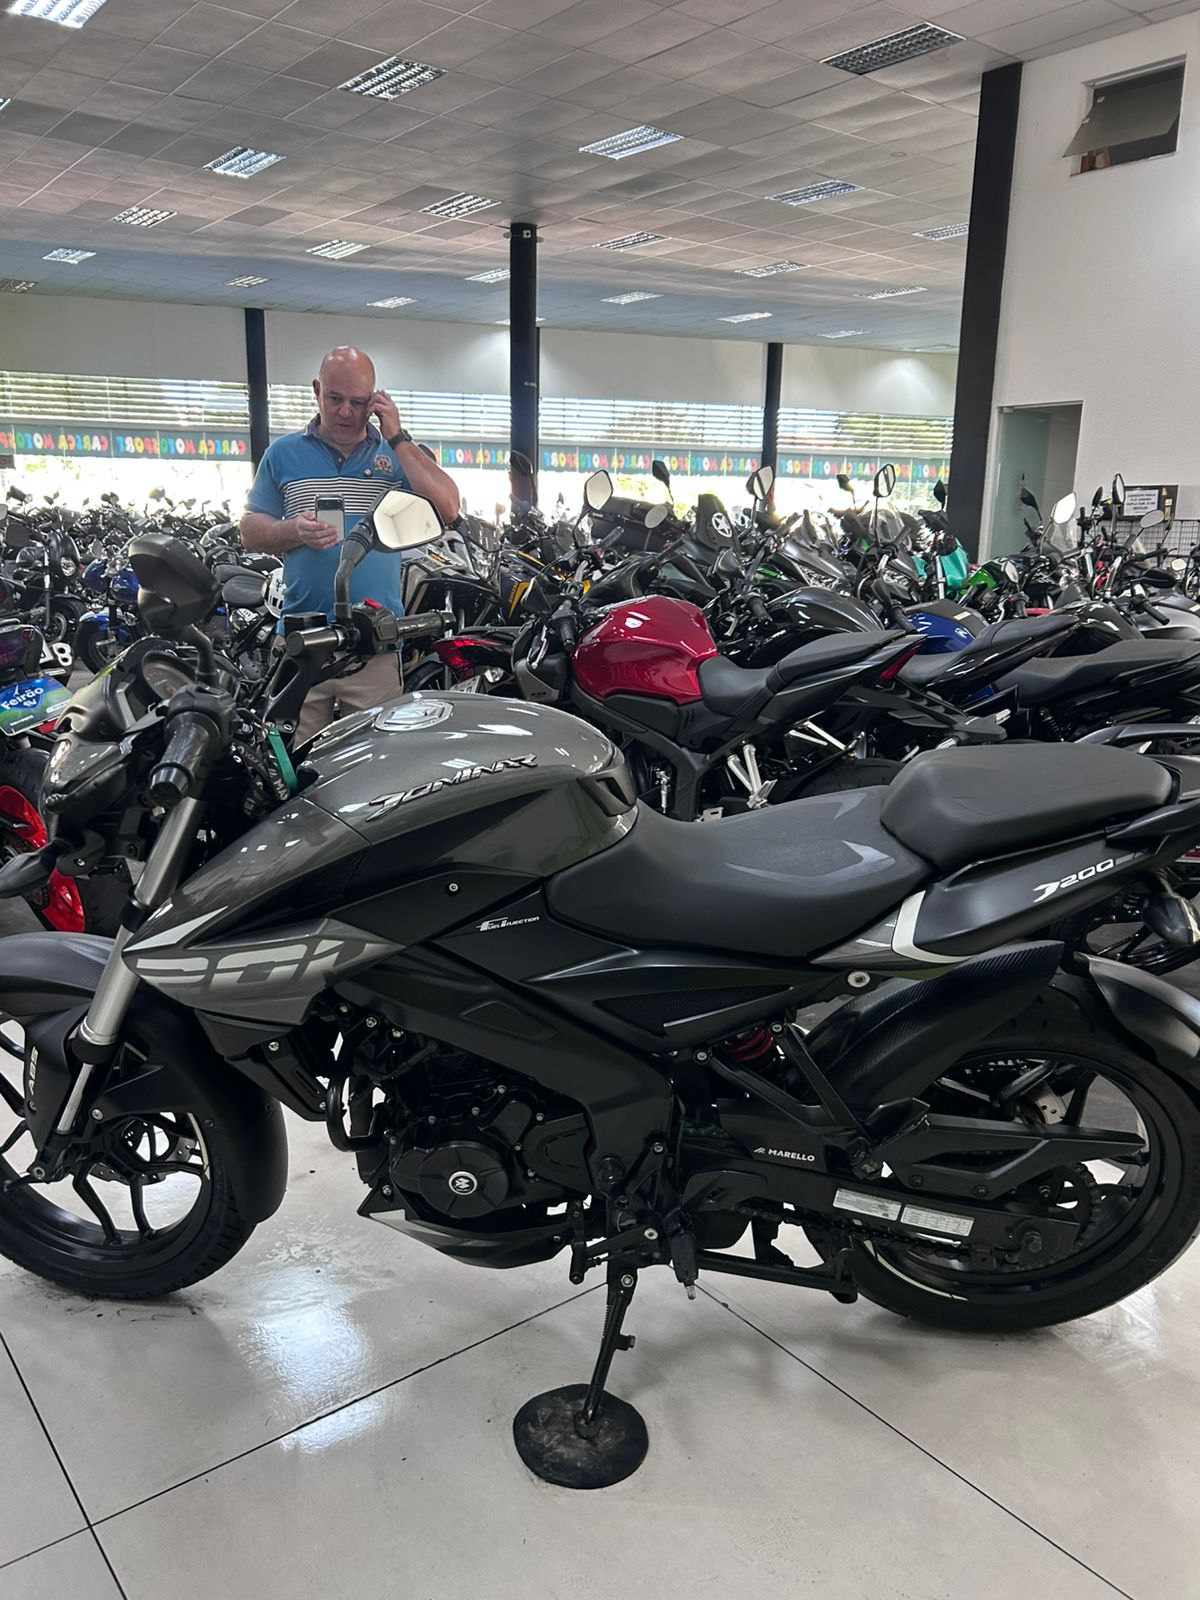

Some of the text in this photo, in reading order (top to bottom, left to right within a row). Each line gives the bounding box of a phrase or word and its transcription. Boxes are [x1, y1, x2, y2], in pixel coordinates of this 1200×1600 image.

[1, 687, 44, 710] Feirão
[28, 1045, 39, 1096] ABS
[767, 1147, 815, 1162] MARELLO
